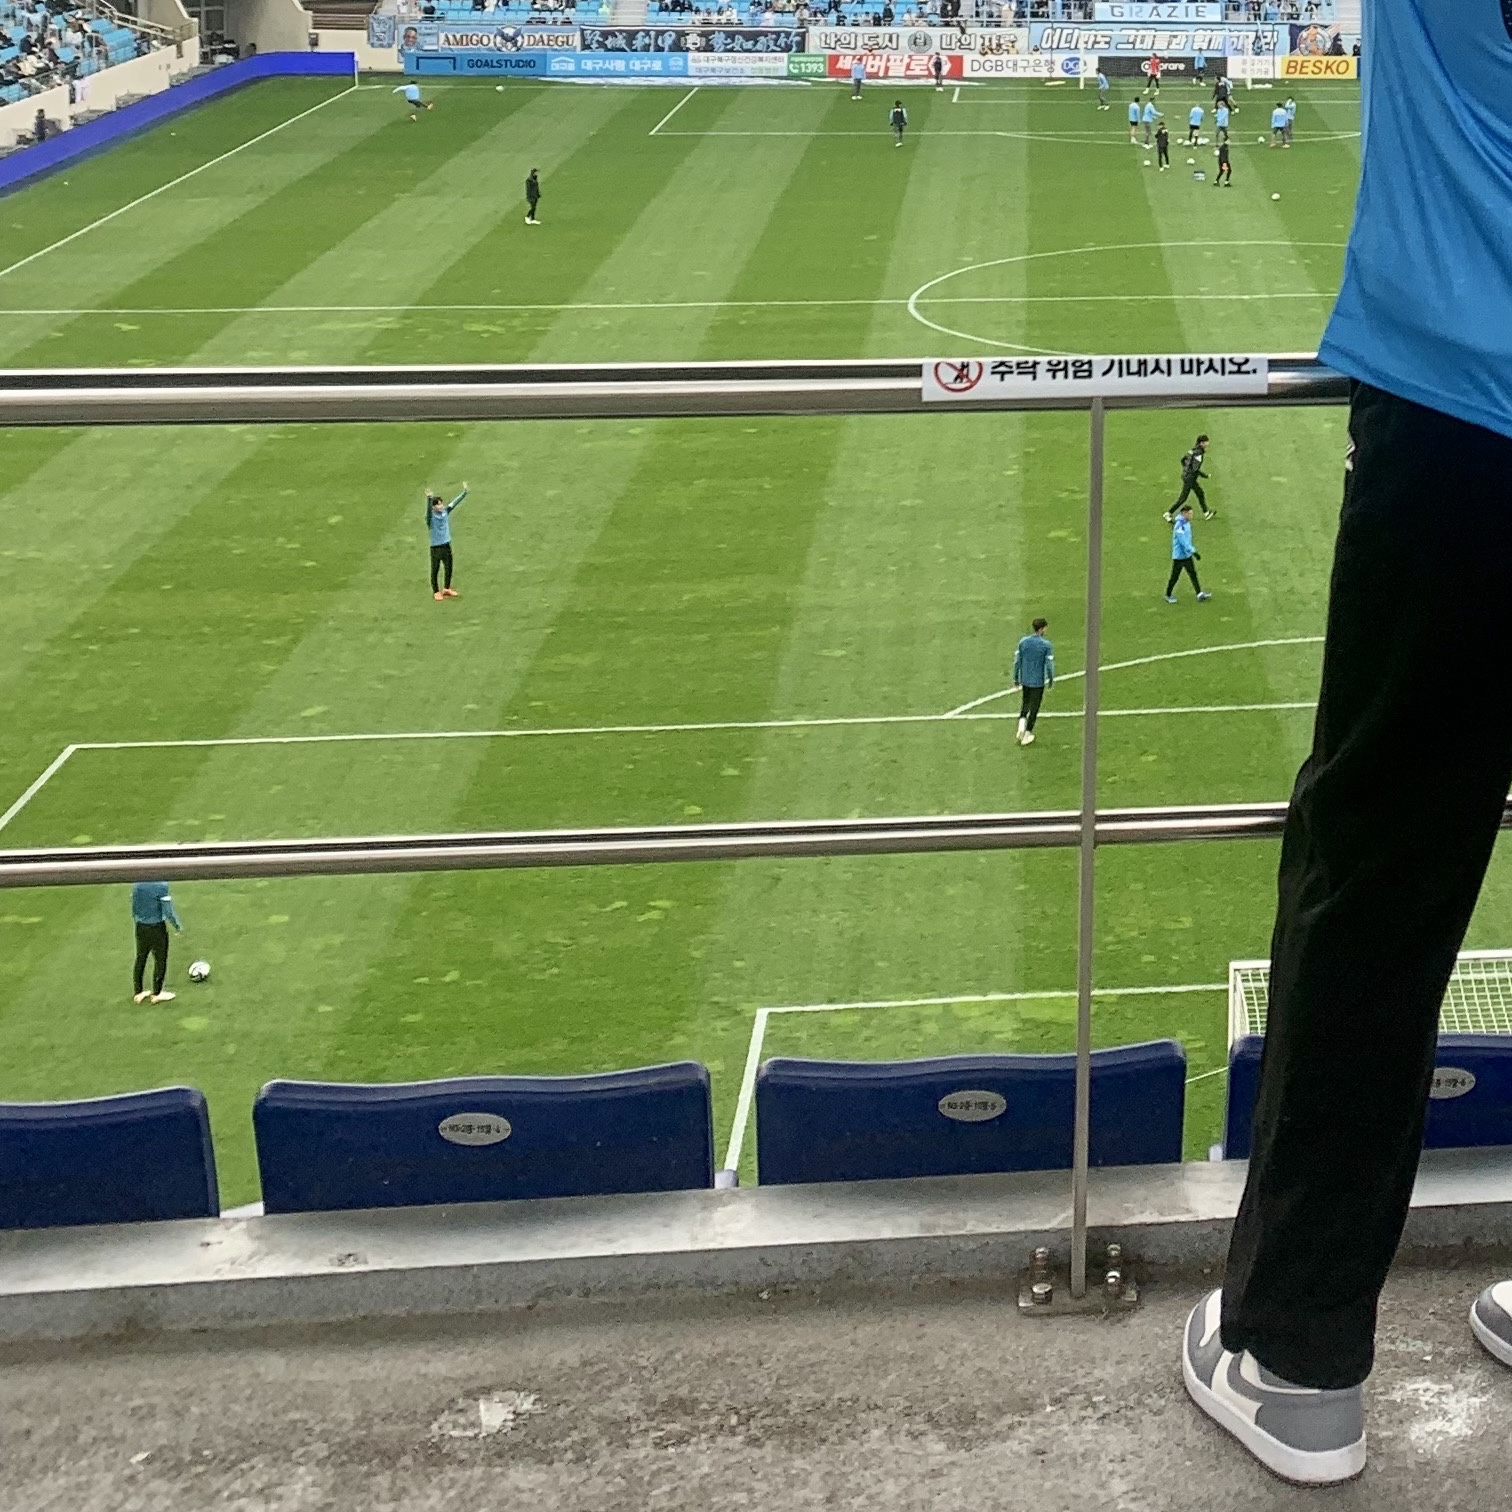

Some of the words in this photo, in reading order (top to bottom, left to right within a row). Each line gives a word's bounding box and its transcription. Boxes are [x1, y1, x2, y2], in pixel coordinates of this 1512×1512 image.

[442, 33, 491, 47] AMIGO
[526, 33, 576, 47] DAEGU
[819, 31, 858, 50] 나의
[861, 32, 899, 50] 도시
[940, 32, 977, 50] 나의
[466, 58, 537, 69] GOALSTUDIO
[801, 63, 824, 73] 1393
[1285, 59, 1350, 76] BESKO
